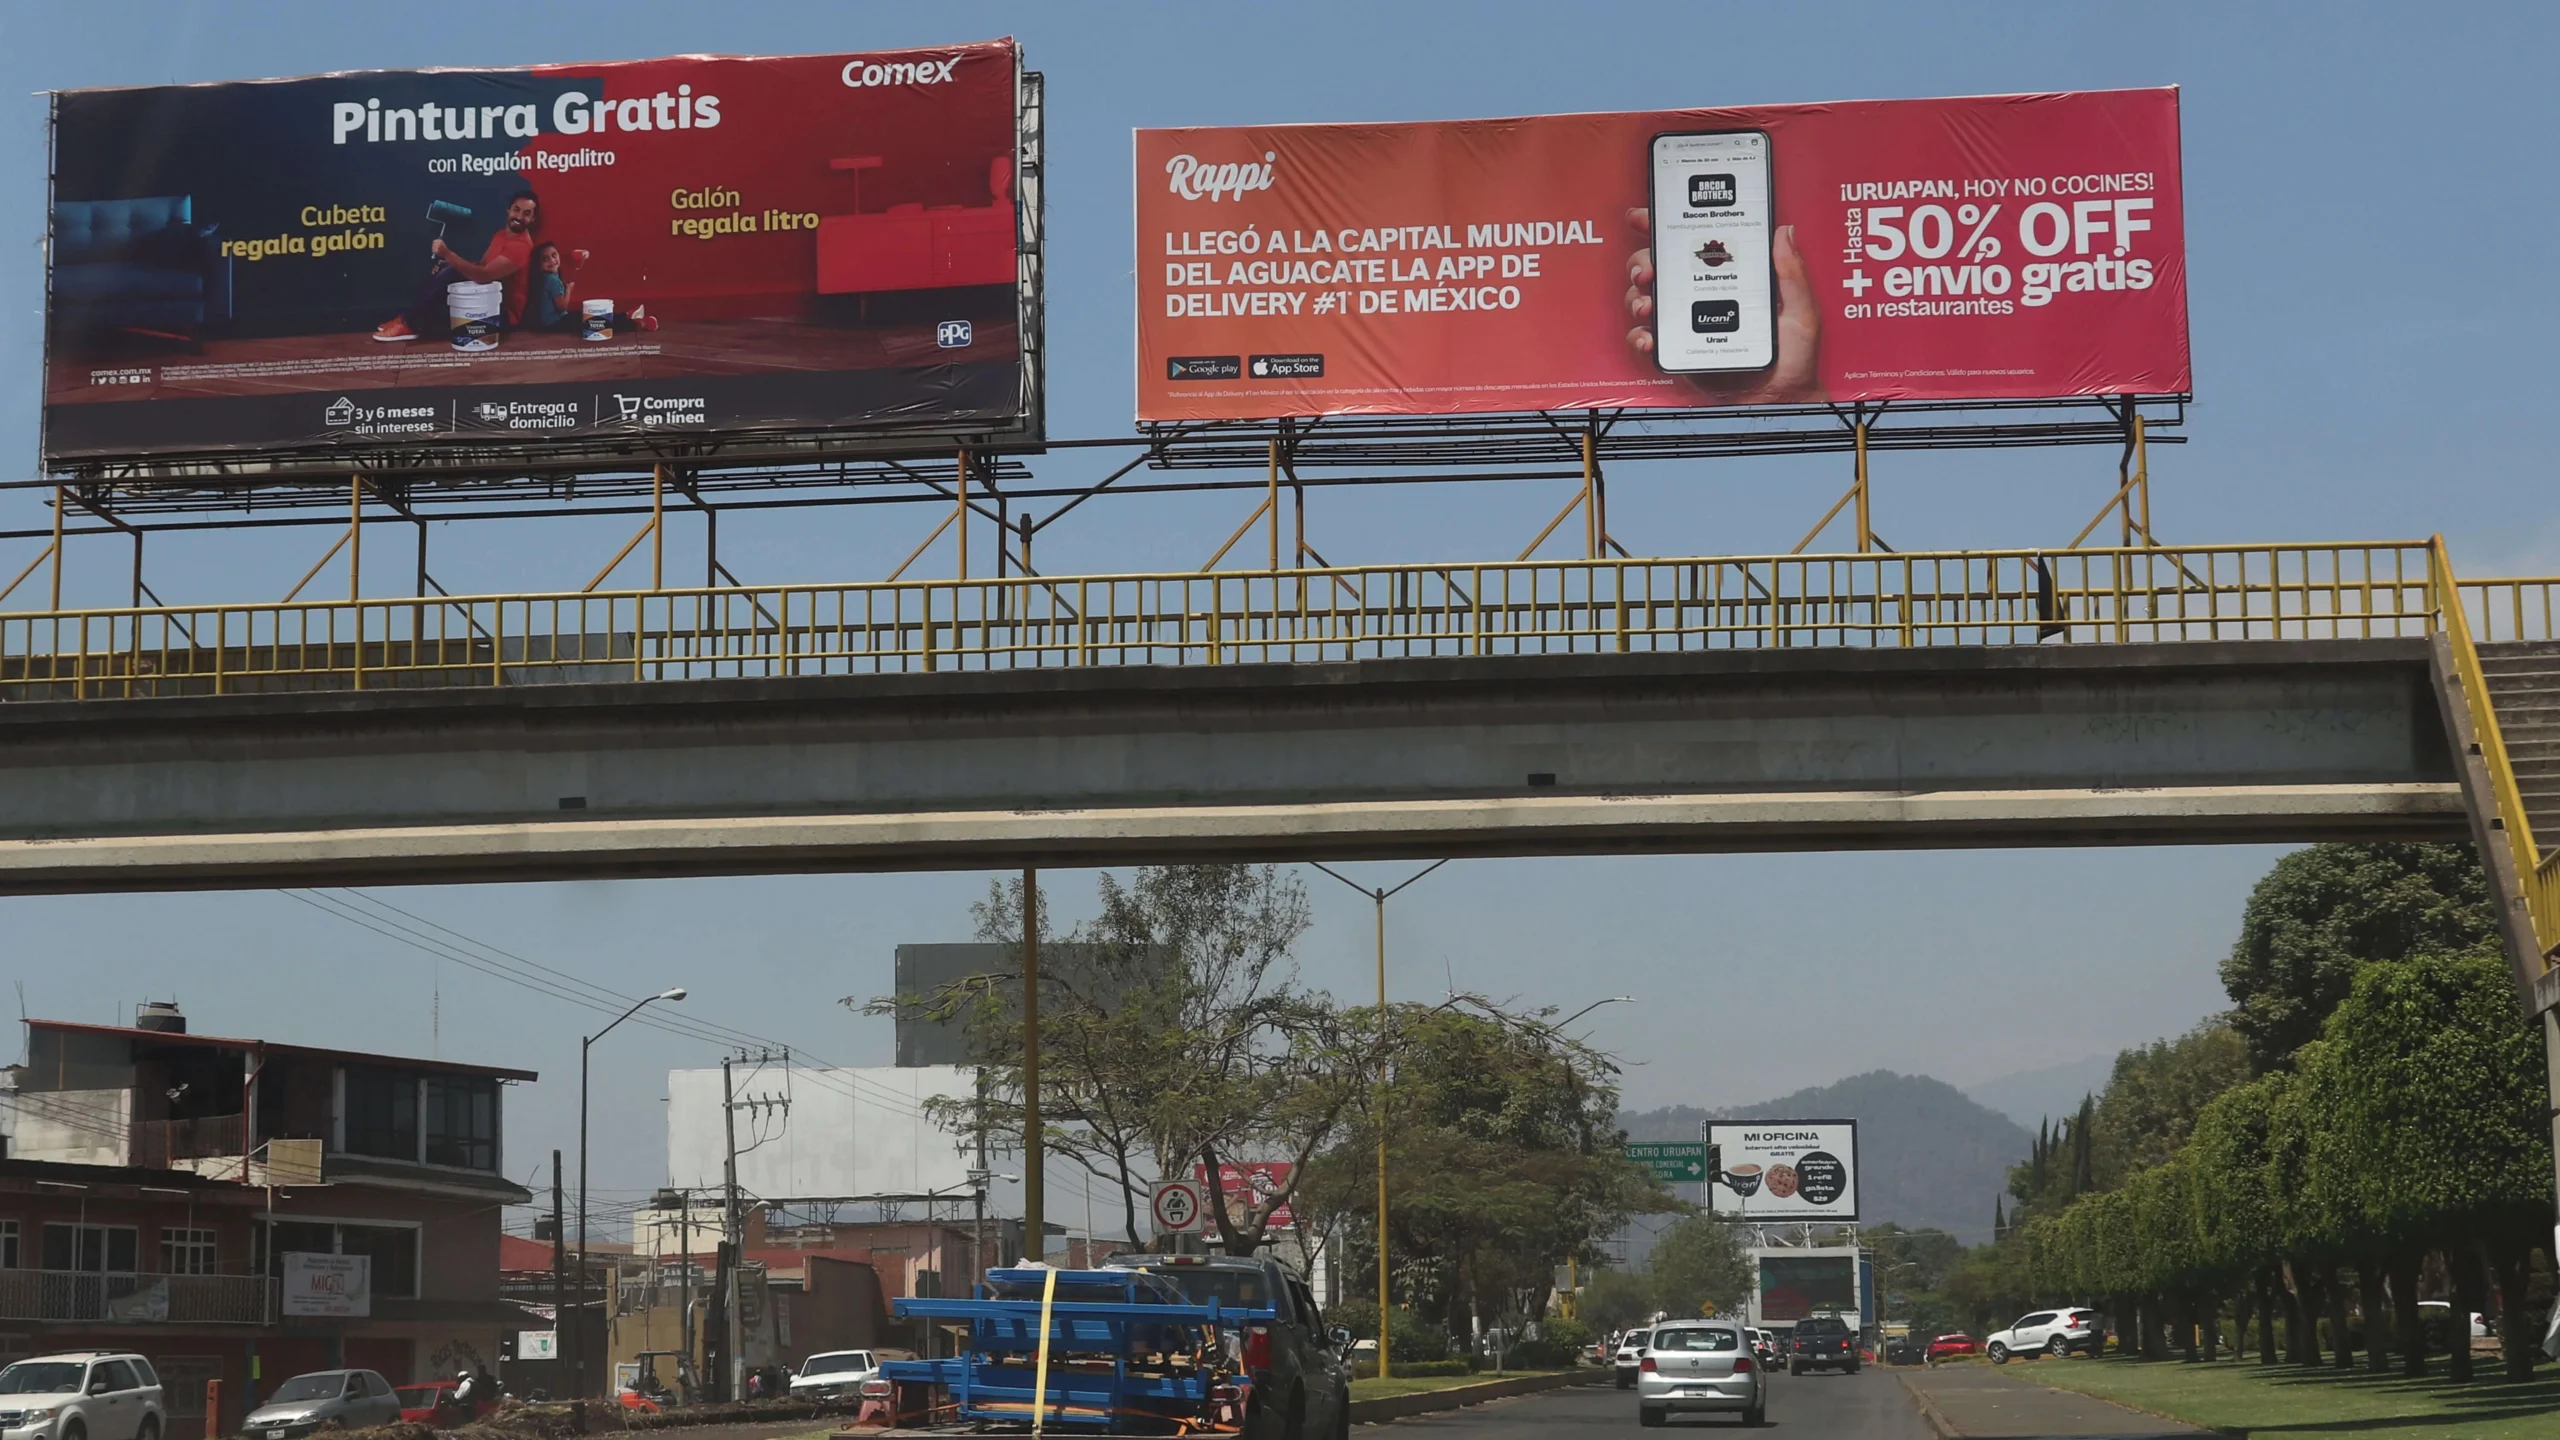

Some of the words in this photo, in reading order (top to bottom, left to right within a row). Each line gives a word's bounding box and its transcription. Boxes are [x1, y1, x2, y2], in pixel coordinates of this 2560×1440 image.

[841, 53, 965, 87] Comex
[333, 98, 538, 144] Pintura
[553, 84, 720, 135] Gratis
[428, 156, 457, 173] con
[462, 151, 531, 175] Regalón
[537, 148, 615, 173] Regalitro
[1165, 150, 1276, 202] Rappi
[1698, 181, 1726, 190] BACON
[1691, 190, 1733, 202] BROTHERS
[1840, 179, 1959, 202] ¡URUAPAN,
[1964, 178, 2009, 198] HOY
[2014, 177, 2045, 196] NO
[2051, 173, 2155, 195] COCINES!
[671, 186, 740, 209] Galón
[301, 204, 385, 227] Cubeta
[671, 211, 757, 239] regala
[764, 209, 819, 230] litro
[1683, 211, 1708, 219] Bacon
[1710, 210, 1745, 218] Brothers
[1165, 223, 1261, 256] LLEGÓ
[1266, 231, 1289, 253] A
[1294, 230, 1332, 252] LA
[1338, 225, 1462, 253] CAPITAL
[1467, 220, 1603, 249] MUNDIAL
[1843, 207, 1863, 264] Hasta
[1865, 204, 2002, 261] 50%
[2019, 198, 2154, 257] OFF
[221, 233, 304, 261] regala
[311, 228, 385, 258] galón
[1166, 262, 1222, 287] DEL
[1226, 258, 1386, 285] AGUACATE
[1391, 258, 1430, 281] LA
[1435, 256, 1494, 280] APP
[1501, 254, 1540, 278] DE
[1842, 268, 1872, 298] +
[1883, 250, 2011, 297] envío
[2022, 247, 2153, 307] gratis
[1166, 291, 1307, 317] DELIVERY
[1359, 290, 1398, 314] DE
[1404, 282, 1521, 312] MÉXICO
[1844, 301, 1871, 319] en
[1877, 296, 2014, 318] restaurantes
[1698, 312, 1732, 323] Urani
[939, 323, 969, 344] PPG
[91, 368, 151, 377] comex.com.mx
[1189, 364, 1219, 375] Google
[1221, 365, 1238, 374] play
[1271, 364, 1292, 375] App
[1293, 363, 1319, 373] Store
[1844, 372, 1868, 380] Aplican
[1869, 370, 1898, 378] Términos
[510, 402, 563, 416] Entrega
[568, 403, 578, 413] a
[644, 396, 705, 412] Compra
[355, 408, 364, 420] 3
[366, 411, 374, 423] y
[376, 407, 385, 420] 6
[388, 405, 434, 418] meses
[510, 416, 576, 429] domicilio
[644, 414, 663, 425] en
[667, 410, 705, 424] línea
[355, 422, 373, 434] sin
[376, 421, 434, 434] intereses
[1744, 1133, 1760, 1141] MI
[1762, 1132, 1819, 1141] OFICINA
[1663, 1147, 1702, 1156] URUAPAN
[1656, 1160, 1685, 1168] COMERCIAL
